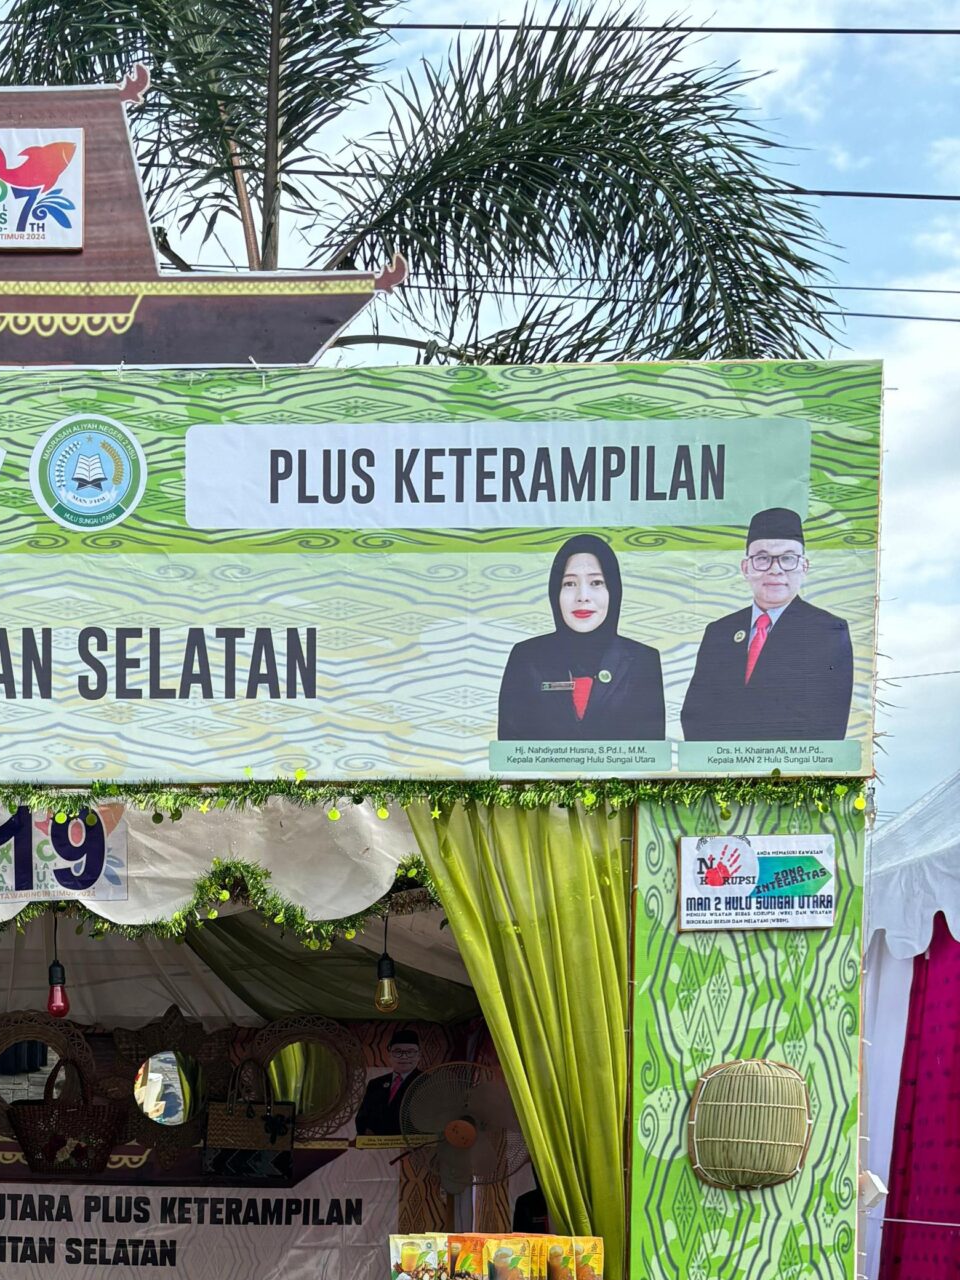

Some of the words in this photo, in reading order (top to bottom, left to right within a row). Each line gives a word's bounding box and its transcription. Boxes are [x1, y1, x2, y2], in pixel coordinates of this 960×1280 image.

[43, 428, 72, 460] MADRASAH
[73, 423, 97, 432] ALIYAH
[98, 424, 123, 440] NEGERI
[269, 448, 375, 504] PLUS
[394, 444, 726, 503] KETERAMPILAN
[64, 512, 78, 523] HULU
[100, 512, 117, 523] UTARA
[77, 626, 317, 701] SELATAN
[515, 746, 526, 755] Hj.
[527, 746, 568, 755] Nahdiyatul
[569, 746, 596, 755] Husna,
[628, 746, 647, 754] M.M.
[775, 747, 788, 755] Ali,
[506, 756, 534, 765] Kepala
[535, 756, 585, 765] Kankemenag
[606, 756, 633, 765] Sungai
[707, 756, 734, 765] Kepala
[783, 756, 810, 765] Sungai
[686, 897, 711, 911] MAN
[714, 897, 722, 911] 2
[725, 896, 752, 910] HULU
[756, 895, 794, 910] SUNGAI
[798, 894, 833, 909] UTARA
[83, 1195, 150, 1224] PLUS
[159, 1196, 363, 1226] KETERAMPILAN
[65, 1238, 176, 1267] SELATAN
